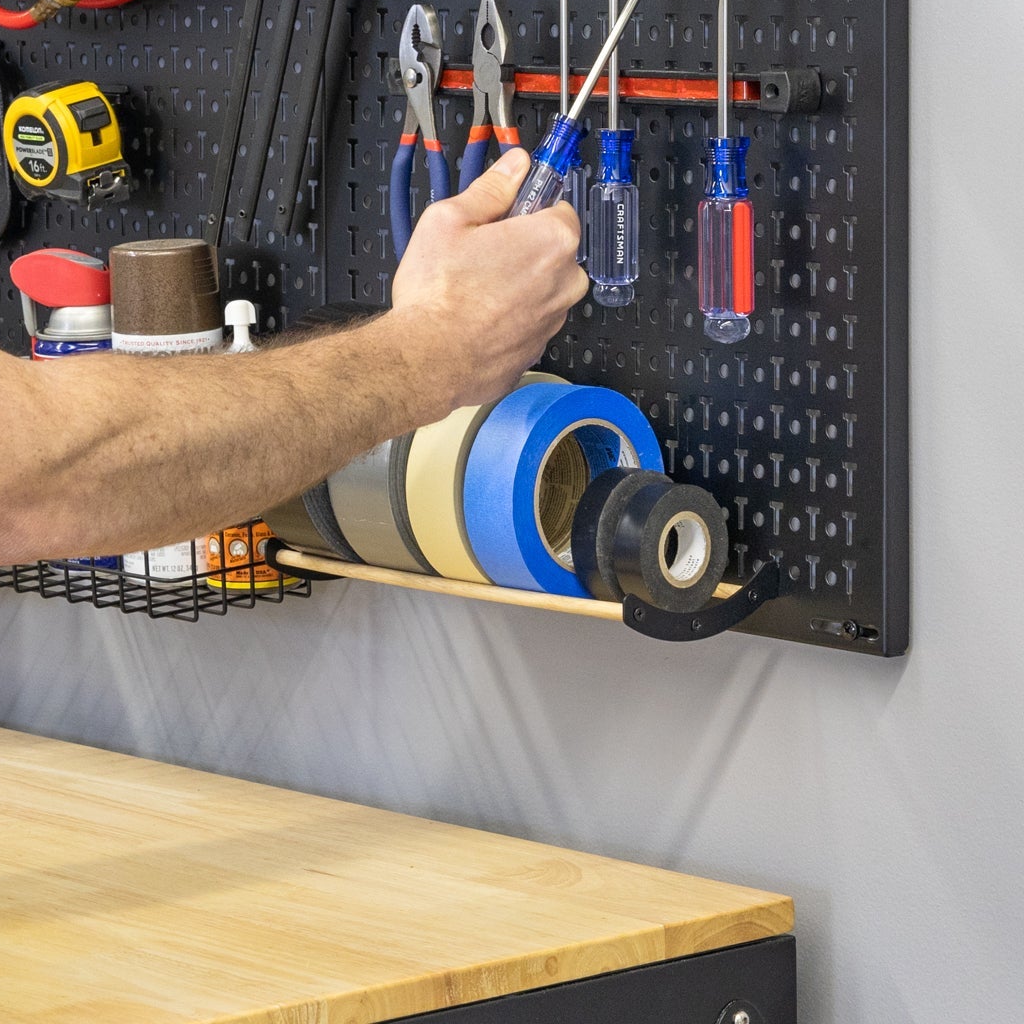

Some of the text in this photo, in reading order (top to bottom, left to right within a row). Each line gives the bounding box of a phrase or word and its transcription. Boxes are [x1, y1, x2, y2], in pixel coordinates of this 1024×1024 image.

[28, 159, 40, 173] 16
[616, 203, 625, 264] CRAFTSMAN
[146, 340, 173, 348] QUALITY
